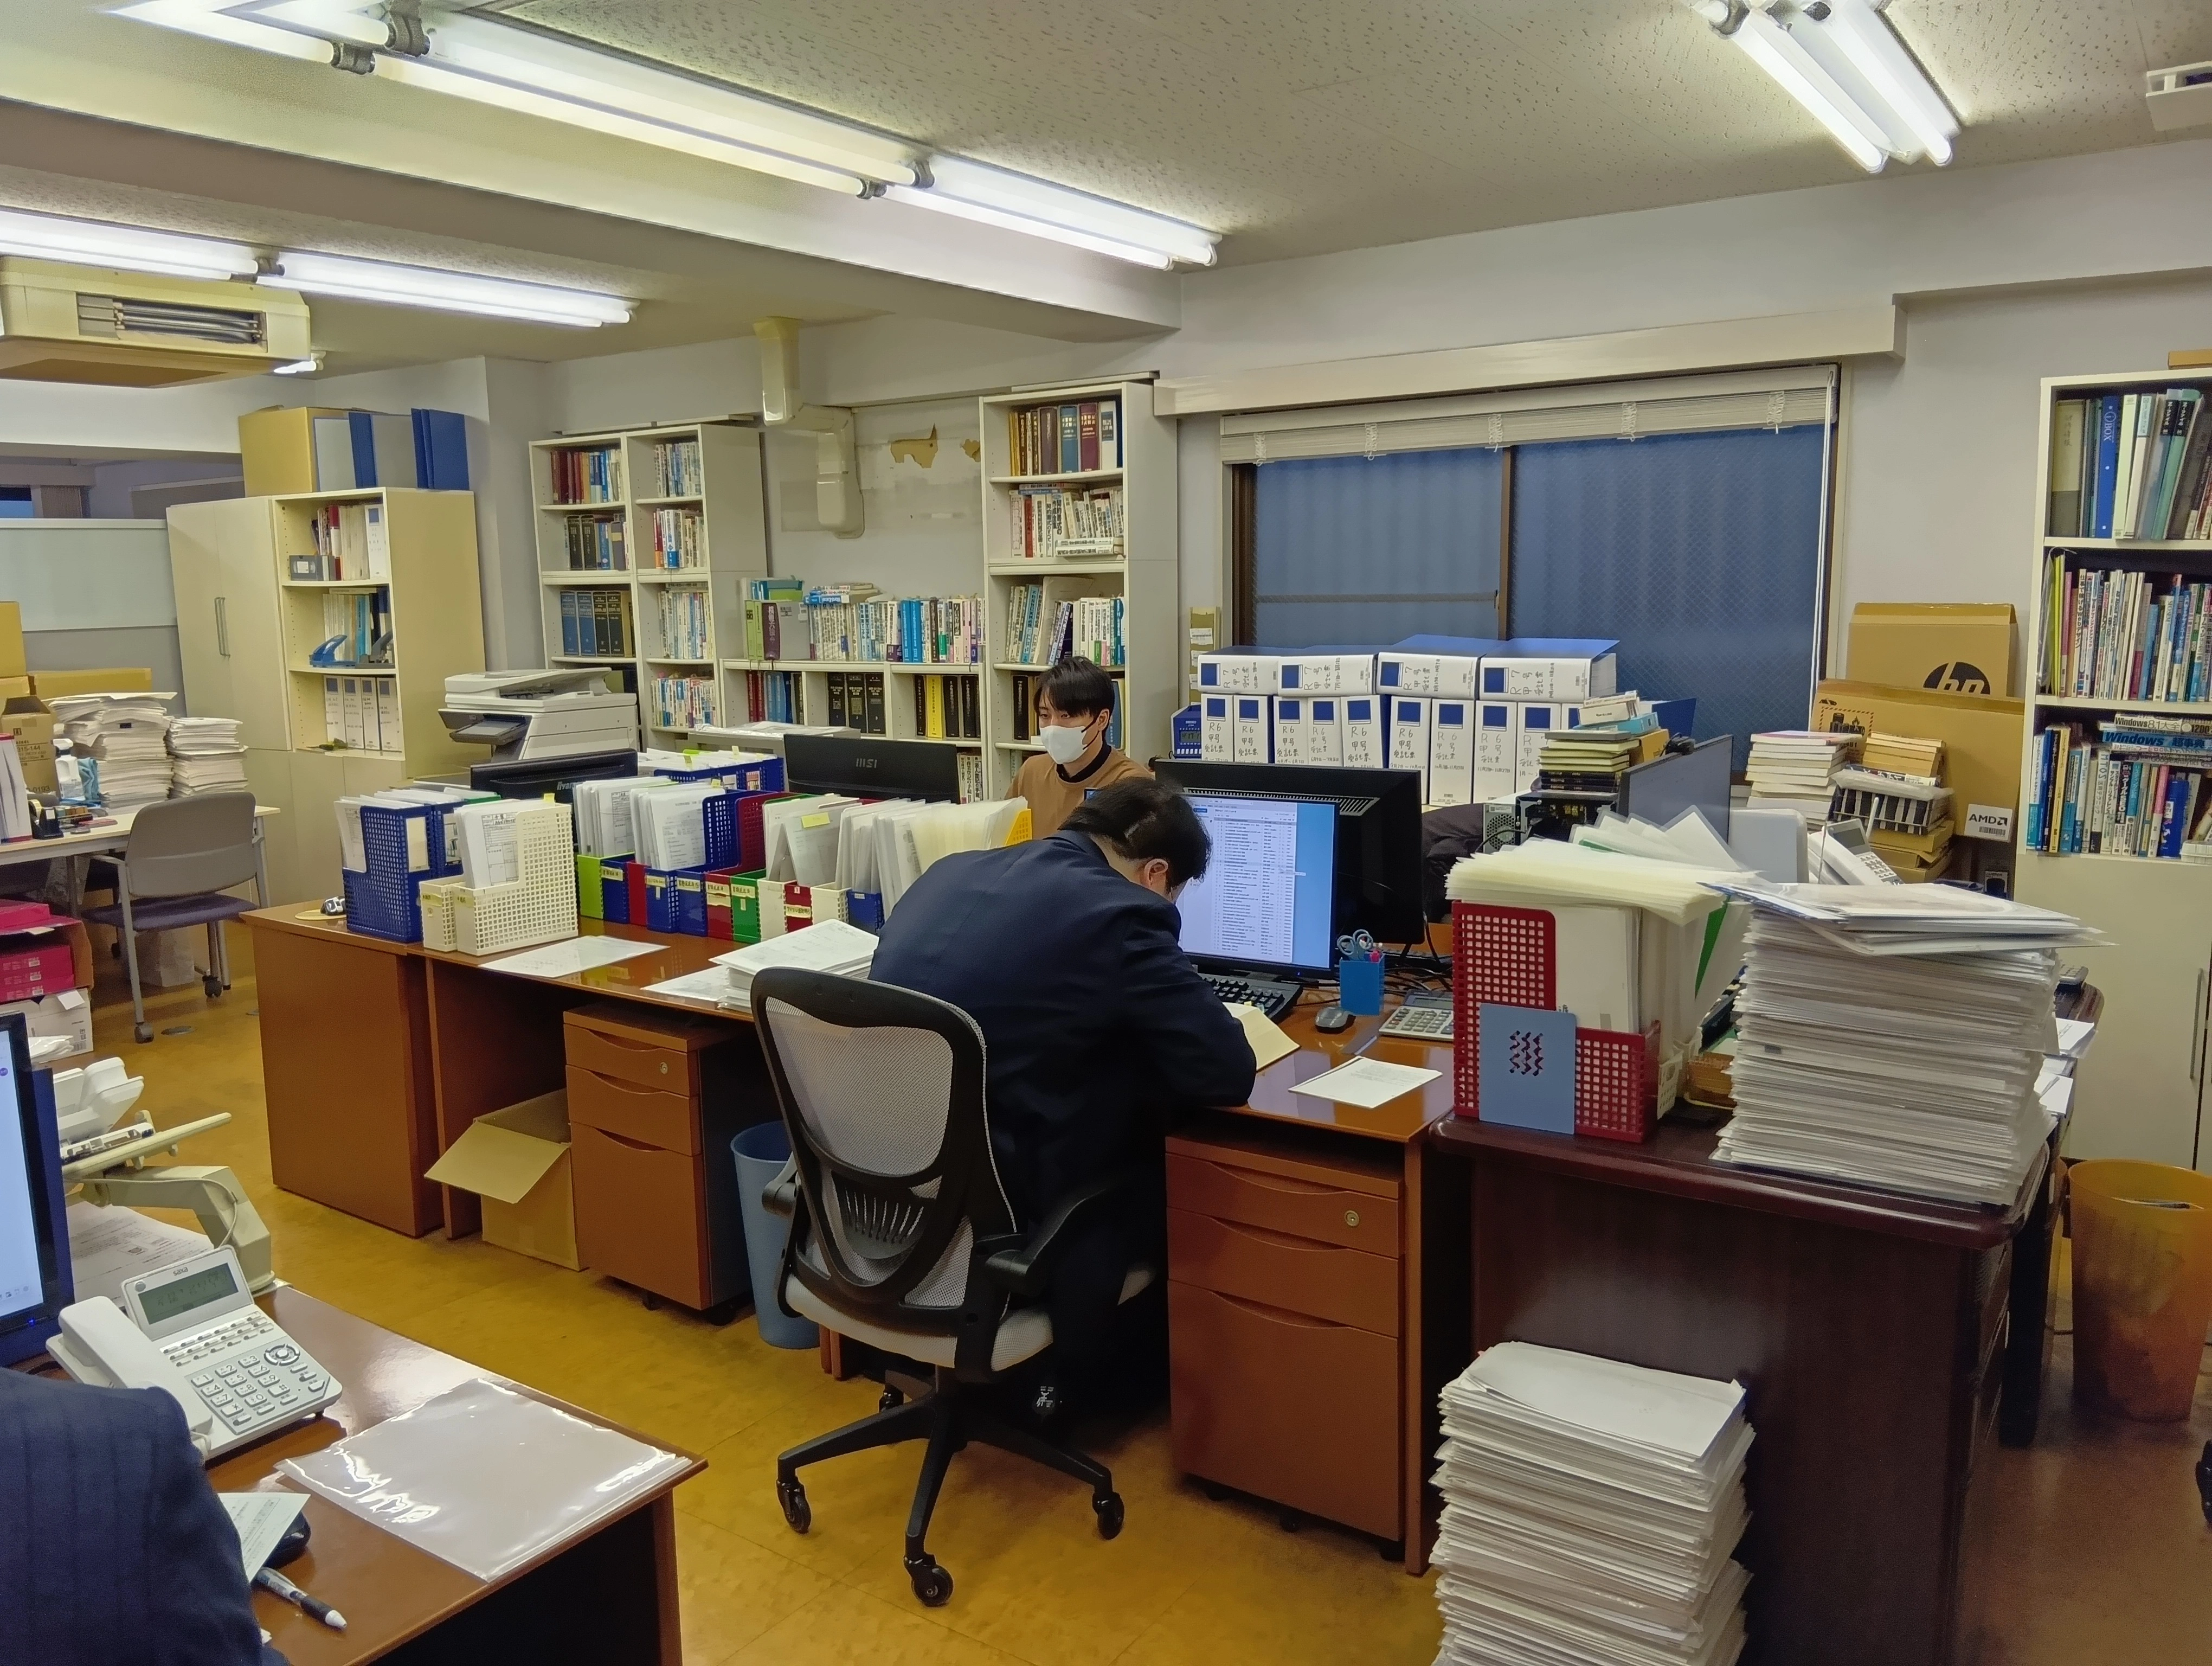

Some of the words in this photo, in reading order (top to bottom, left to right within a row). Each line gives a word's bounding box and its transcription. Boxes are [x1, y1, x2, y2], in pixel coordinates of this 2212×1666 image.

[2104, 732, 2165, 746] Windows
[1968, 813, 1997, 824] AMD
[172, 1266, 189, 1276] saxa
[279, 1383, 288, 1392] #
